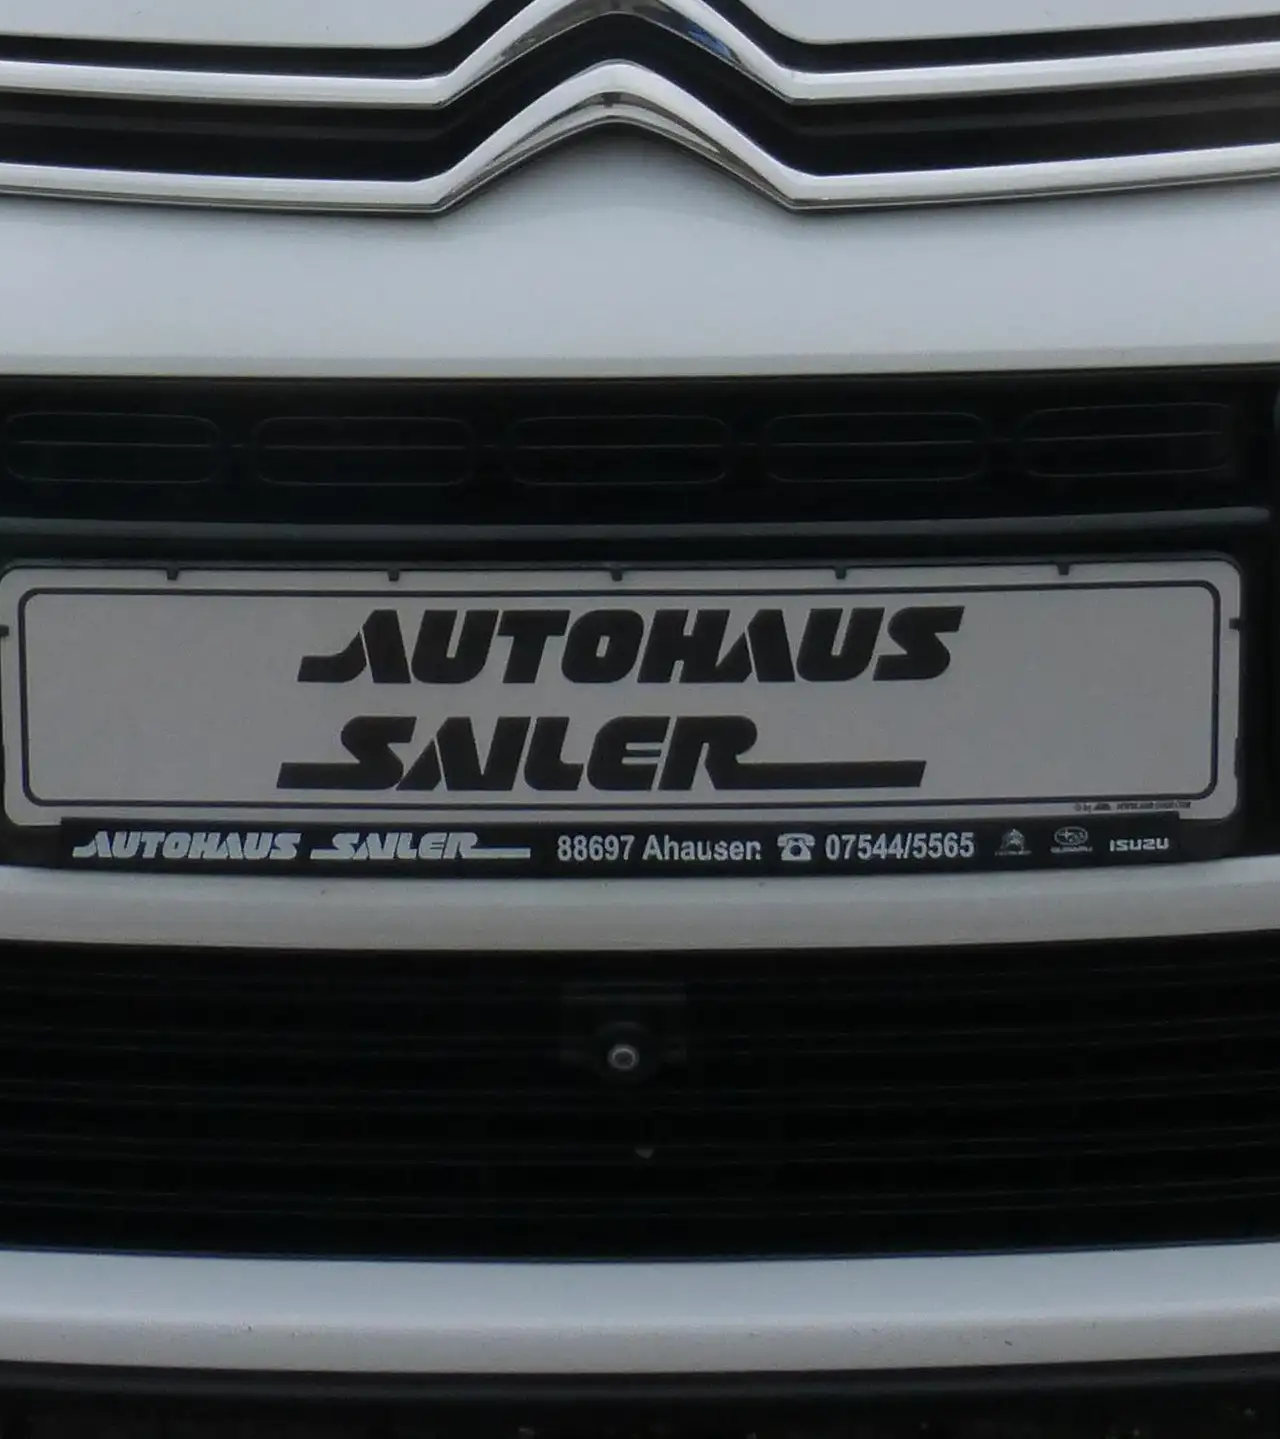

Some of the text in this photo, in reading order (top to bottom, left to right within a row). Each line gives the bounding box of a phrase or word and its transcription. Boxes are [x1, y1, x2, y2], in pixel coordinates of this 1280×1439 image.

[297, 606, 965, 683] AUTOHAUS
[276, 716, 927, 791] SAILER
[72, 830, 301, 859] AUTOHAUS
[310, 831, 531, 860] SAILER
[557, 834, 635, 861] 88697
[825, 831, 975, 860] 07544/5565
[1109, 837, 1170, 852] ISUZU
